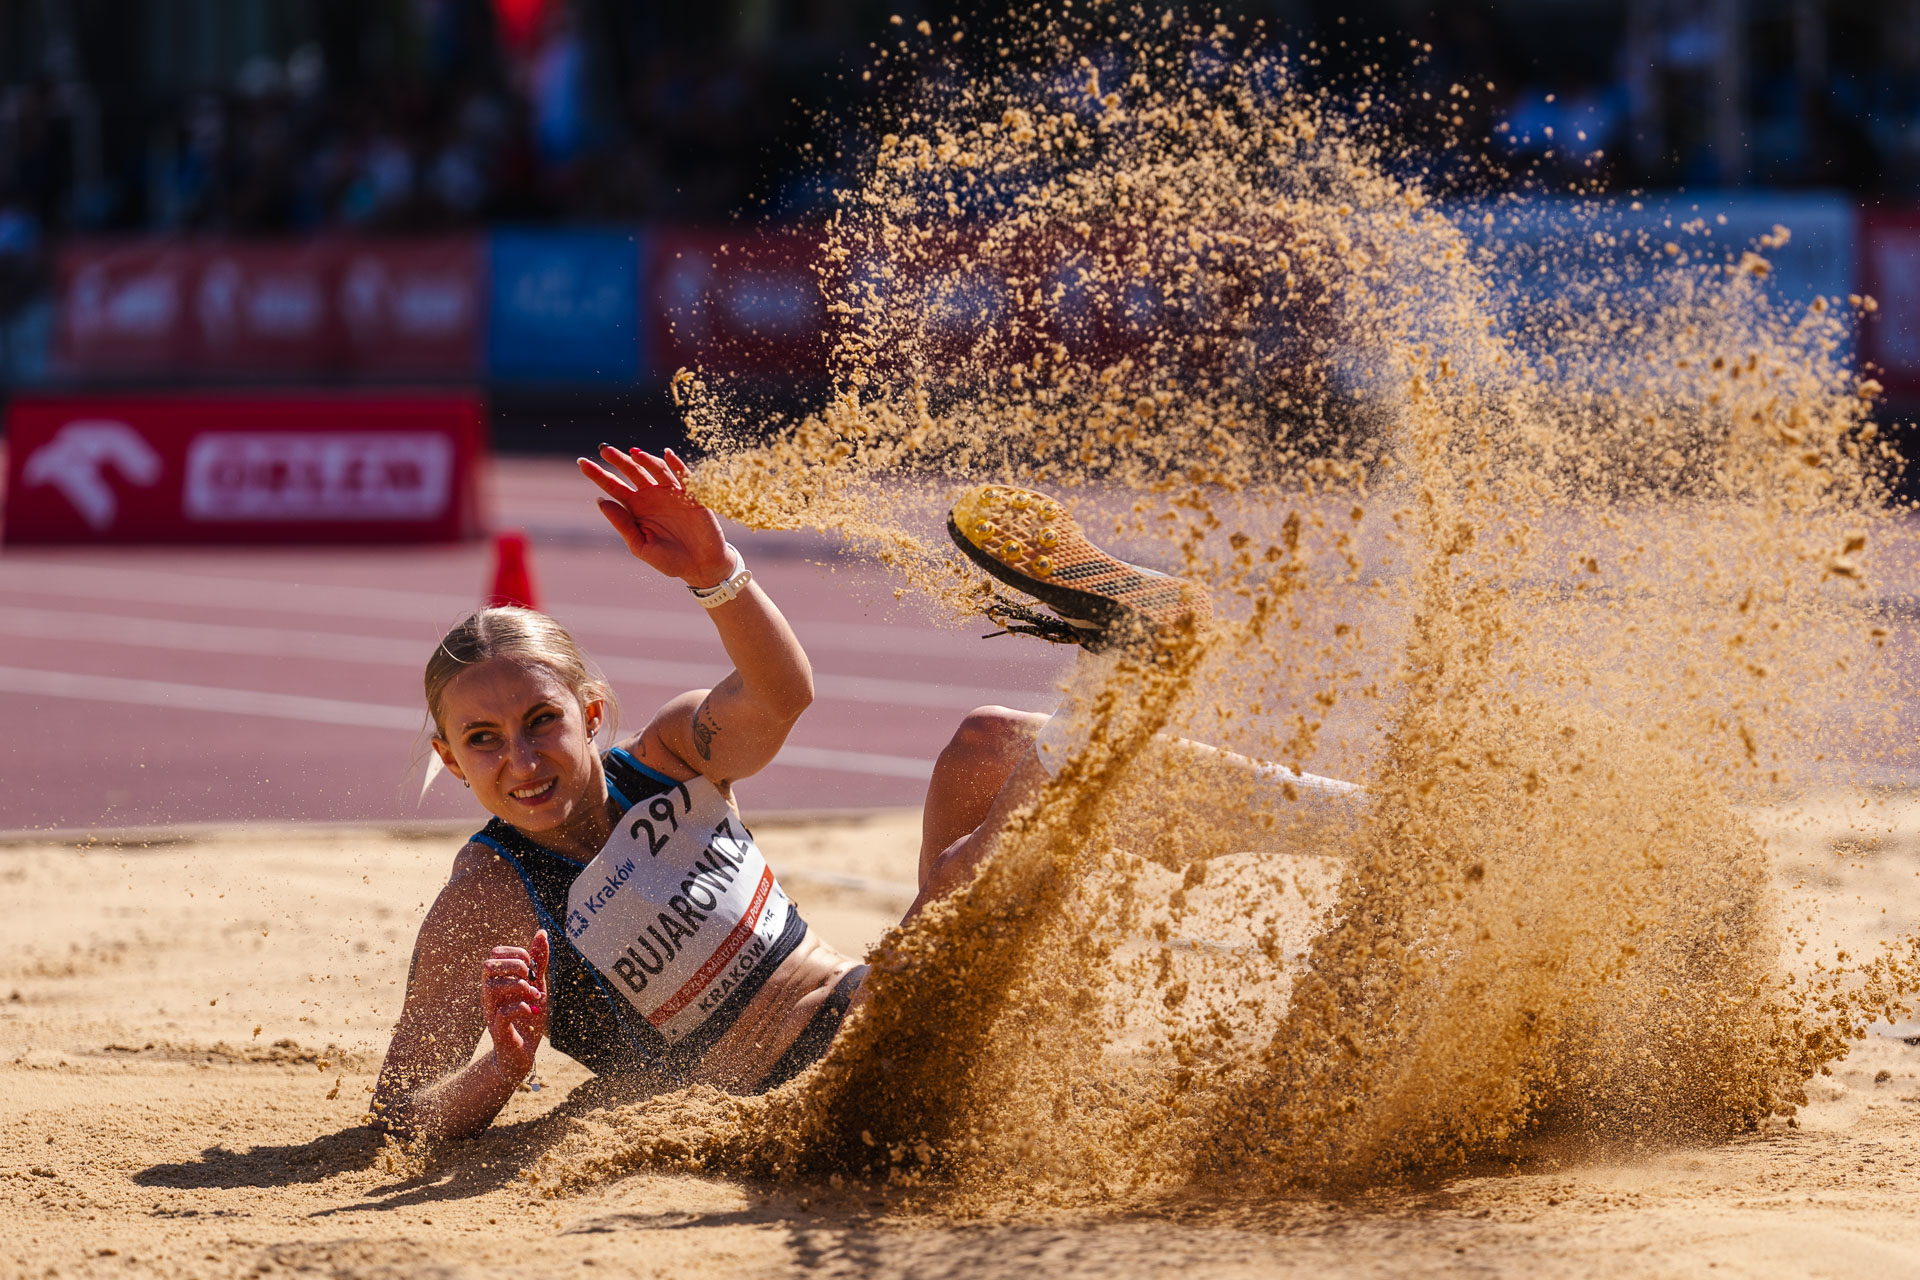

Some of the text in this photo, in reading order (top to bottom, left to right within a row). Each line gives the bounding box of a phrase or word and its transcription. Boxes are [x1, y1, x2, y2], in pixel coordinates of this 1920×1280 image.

[584, 858, 636, 914] Kraków
[612, 817, 749, 993] BUJAROWICZ
[706, 916, 755, 973] Mistrzostwa
[750, 894, 763, 919] Polski
[759, 877, 770, 896] U23
[698, 908, 775, 1012] KRAKÓW 225
